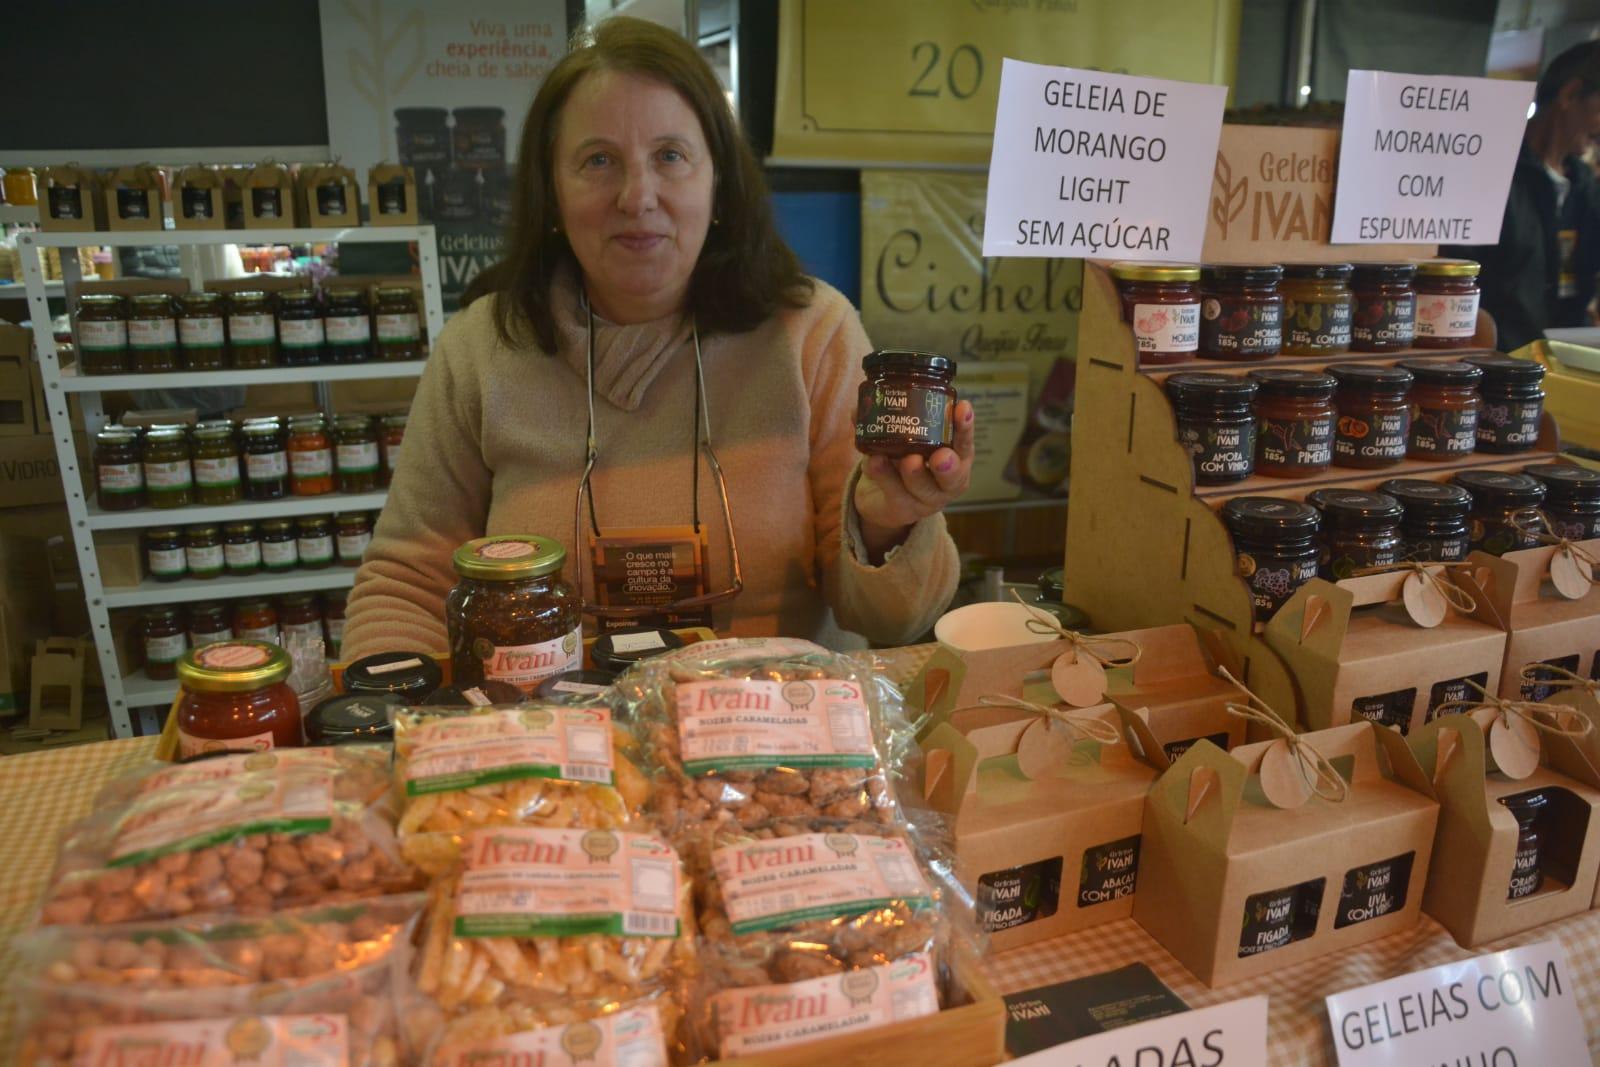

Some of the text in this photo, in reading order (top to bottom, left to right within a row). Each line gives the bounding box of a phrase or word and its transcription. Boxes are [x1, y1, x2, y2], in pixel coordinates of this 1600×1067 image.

[470, 18, 553, 38] Viva uma
[446, 39, 552, 59] experiência,
[427, 60, 548, 78] cheia de sabo
[908, 40, 985, 101] 20
[1044, 80, 1168, 118] GELEIA DE
[1400, 85, 1470, 113] GELEIA
[1034, 126, 1166, 163] MORANGO
[1374, 128, 1482, 157] MORANGO
[1260, 151, 1331, 184] Geleia
[1060, 176, 1130, 205] LIGHT
[1398, 174, 1443, 198] COM
[1251, 191, 1332, 241] IVAN
[1016, 217, 1170, 253] SEM AÇÚCAR
[1359, 217, 1472, 241] ESPUMANTE
[1242, 337, 1262, 346] COM
[1316, 335, 1335, 344] COM
[1376, 330, 1396, 339] COM
[884, 396, 908, 408] IVANI
[876, 414, 920, 426] MORANGO
[866, 423, 884, 433] COM
[886, 423, 929, 437] ESPUMANTE
[1507, 432, 1525, 442] COM
[1217, 435, 1240, 446] IVANI
[1416, 440, 1436, 449] 185g
[1212, 451, 1243, 462] AMORA
[1264, 452, 1286, 463] 185g
[1298, 449, 1331, 464] PIMENTA
[1335, 445, 1356, 455] 185g
[1361, 445, 1383, 456] COM
[1200, 460, 1249, 472] COM VINHO
[626, 551, 676, 562] O que mais
[1441, 545, 1461, 557] IVANI
[626, 561, 656, 569] cresce
[627, 567, 674, 578] campo é a
[627, 575, 671, 584] cultura da
[1256, 598, 1272, 608] 85g
[496, 644, 556, 671] Ivani
[696, 685, 770, 711] Ivani
[735, 716, 808, 725] CARAMELADAS
[479, 835, 569, 864] Ivani
[736, 837, 814, 873] Ivani
[1108, 854, 1133, 870] IVANI
[1513, 855, 1537, 869] IVANI
[779, 863, 857, 879] CARAMELADAS
[1102, 872, 1135, 889] ABACAT
[1367, 872, 1391, 889] IVANI
[992, 885, 1021, 900] IVANI
[1081, 890, 1110, 902] COM
[1368, 892, 1387, 908] UVA
[984, 906, 1023, 922] FIGADA
[1265, 904, 1290, 921] IVANI
[1347, 908, 1374, 922] COM
[738, 981, 828, 1027] Ivani
[1341, 960, 1563, 1051] GELEIAS COM
[1011, 1004, 1052, 1022] IVANI
[785, 1014, 870, 1039] CARAMELADAS
